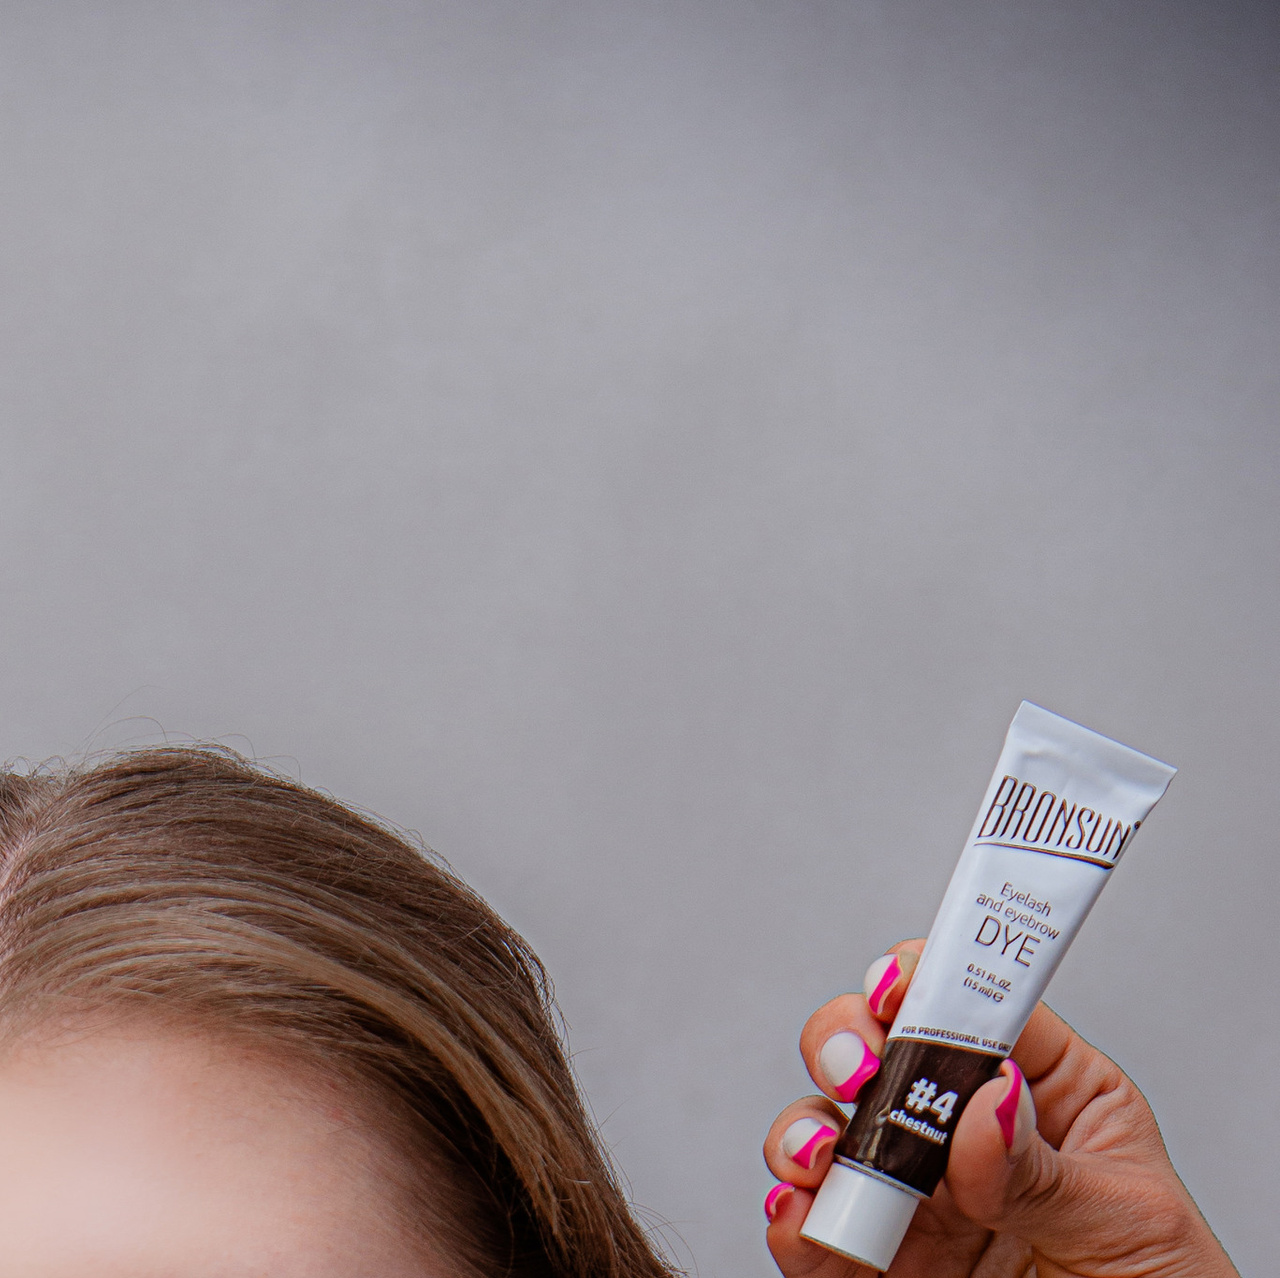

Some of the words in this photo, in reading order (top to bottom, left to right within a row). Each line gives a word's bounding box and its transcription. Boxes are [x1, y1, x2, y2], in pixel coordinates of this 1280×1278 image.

[977, 774, 1132, 860] BRONSUN
[976, 893, 1005, 913] and
[1004, 906, 1060, 940] eyebrow
[1000, 881, 1052, 917] Eyelash
[975, 915, 1041, 968] DYE
[967, 963, 987, 979] 0.51
[901, 1026, 918, 1034] FOR
[918, 1026, 980, 1046] PROFESSIONAL
[981, 1038, 998, 1049] USE
[905, 1077, 959, 1125] #4
[889, 1109, 948, 1145] chestnut
